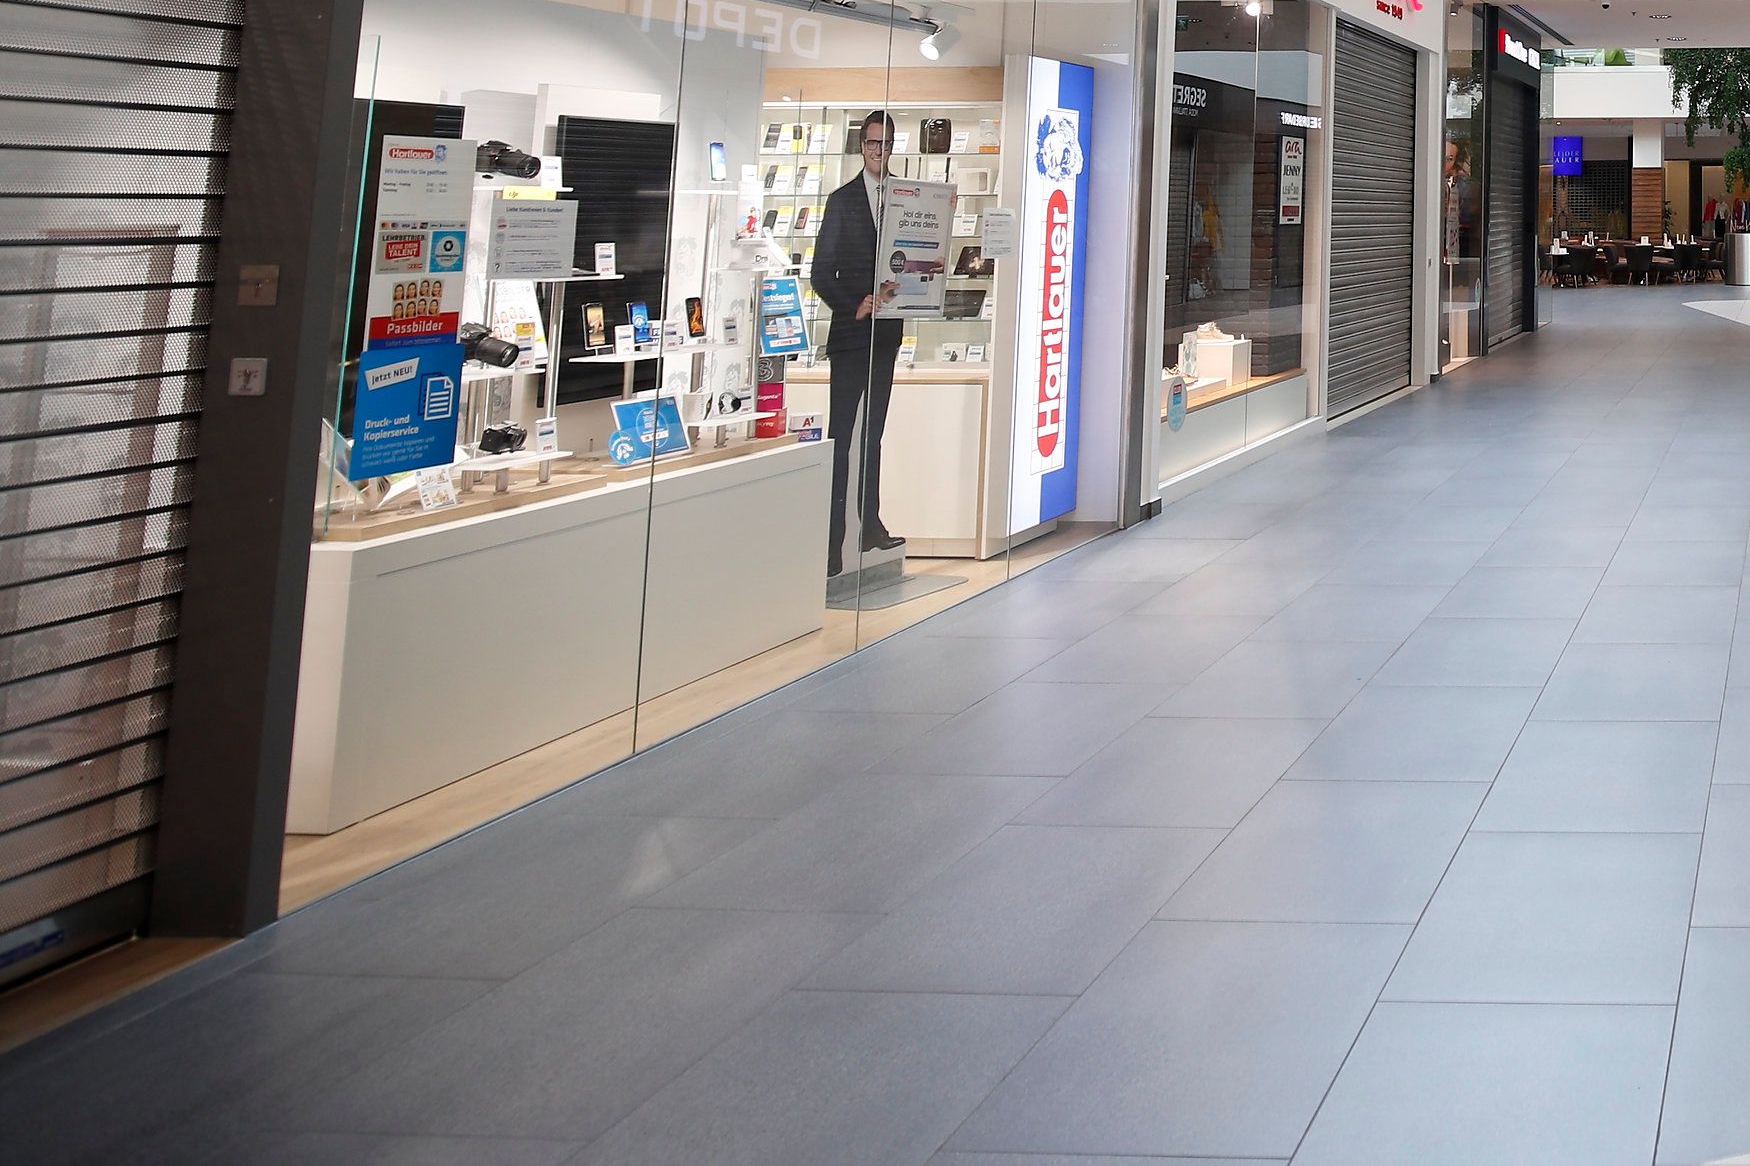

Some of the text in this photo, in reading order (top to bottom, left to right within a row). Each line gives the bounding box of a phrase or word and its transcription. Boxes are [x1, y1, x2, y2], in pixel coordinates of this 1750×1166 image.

[392, 148, 431, 159] Hartlauer
[1285, 141, 1302, 155] ara
[389, 248, 418, 257] TALENT
[387, 321, 443, 335] Passbilder
[1037, 207, 1068, 438] Hartlauer
[393, 366, 413, 377] NEU!
[365, 415, 410, 429] Druck- und
[363, 426, 419, 442] Kopierservice
